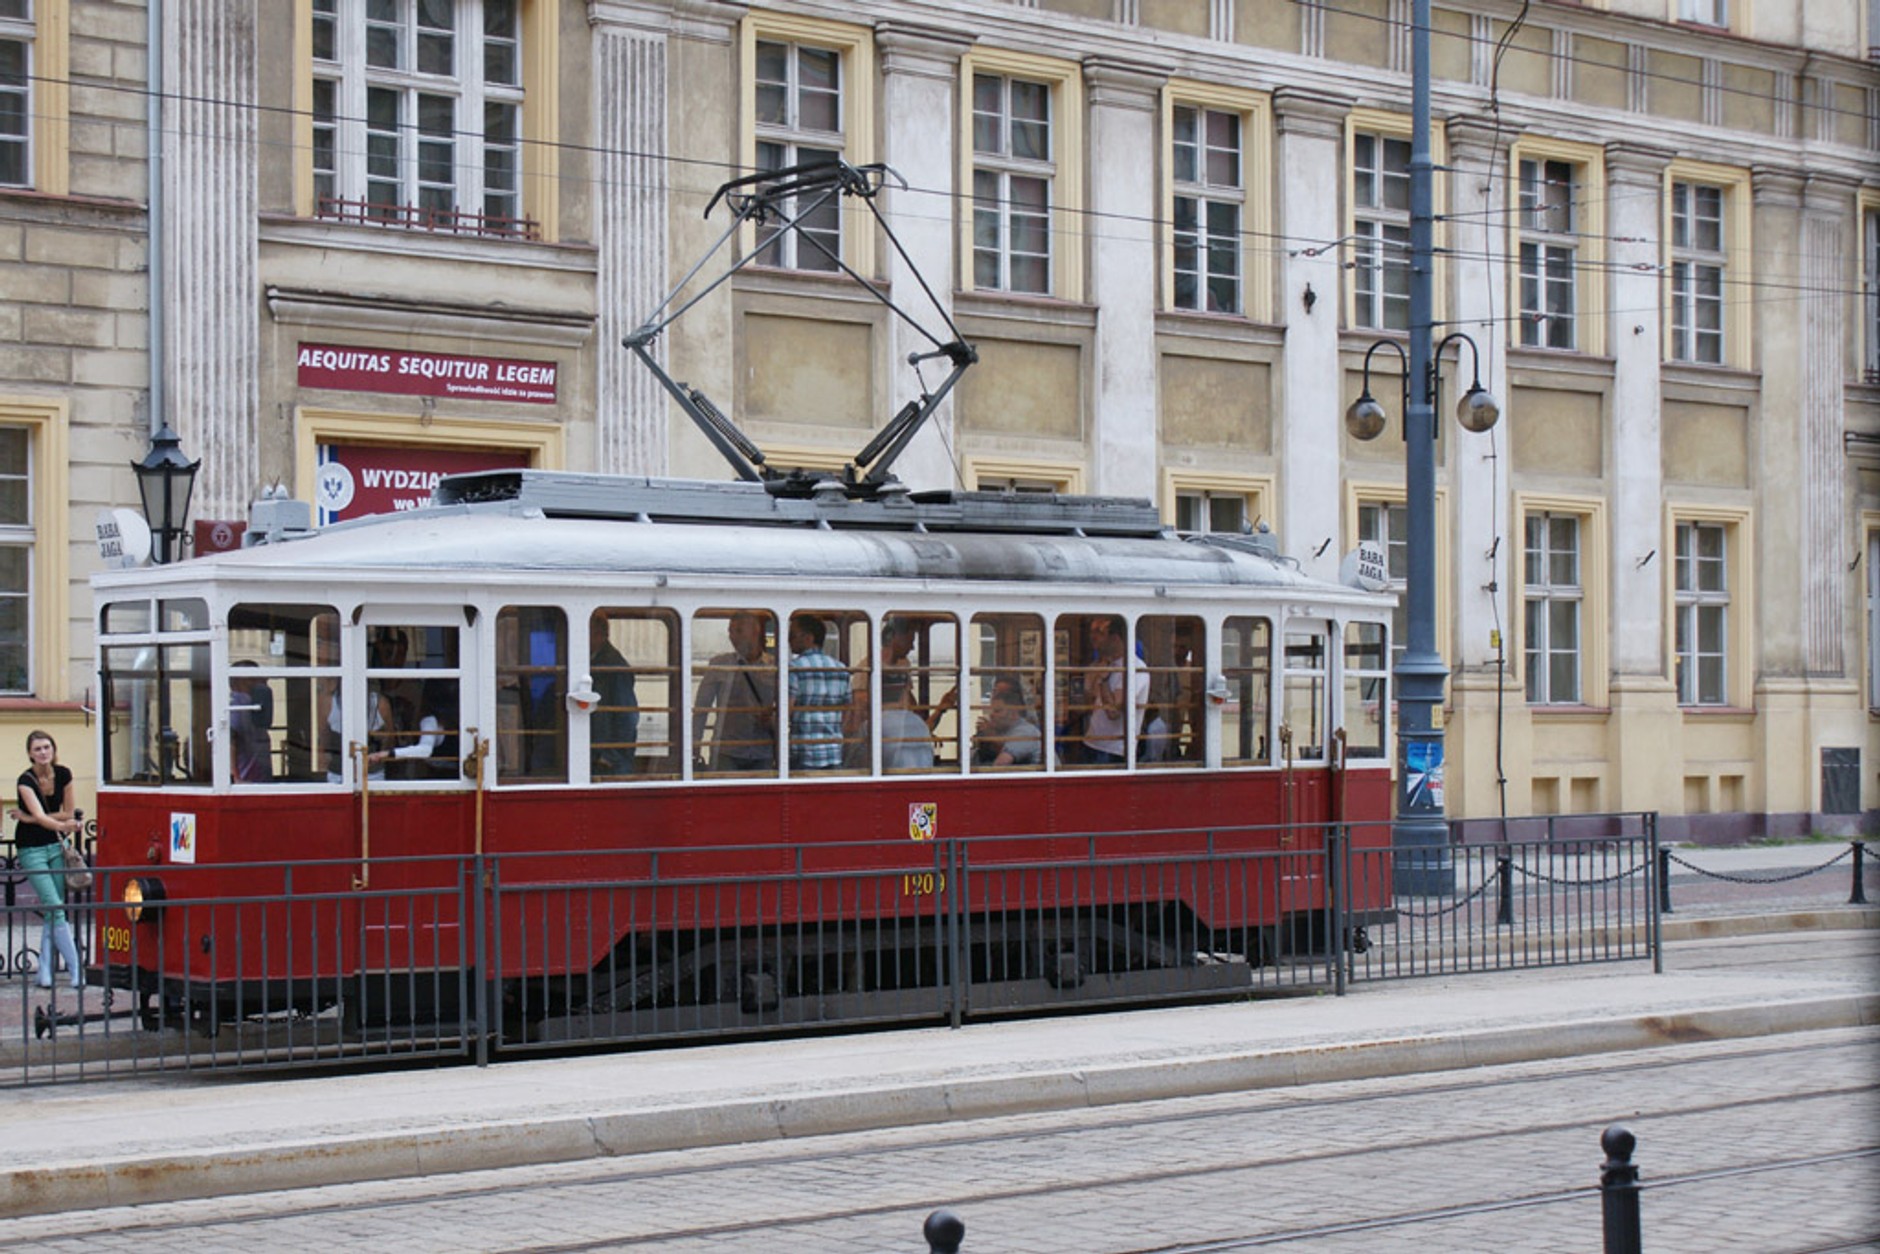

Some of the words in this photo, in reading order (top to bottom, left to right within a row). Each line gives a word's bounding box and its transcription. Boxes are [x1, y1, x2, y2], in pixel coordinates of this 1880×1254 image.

[298, 349, 391, 372] AEQUITAS
[398, 357, 488, 380] SEQUITUR
[496, 364, 556, 385] LEGEM
[361, 468, 448, 490] WYDZIA
[393, 498, 416, 511] we
[1360, 549, 1384, 567] BABA
[102, 926, 130, 952] 1209
